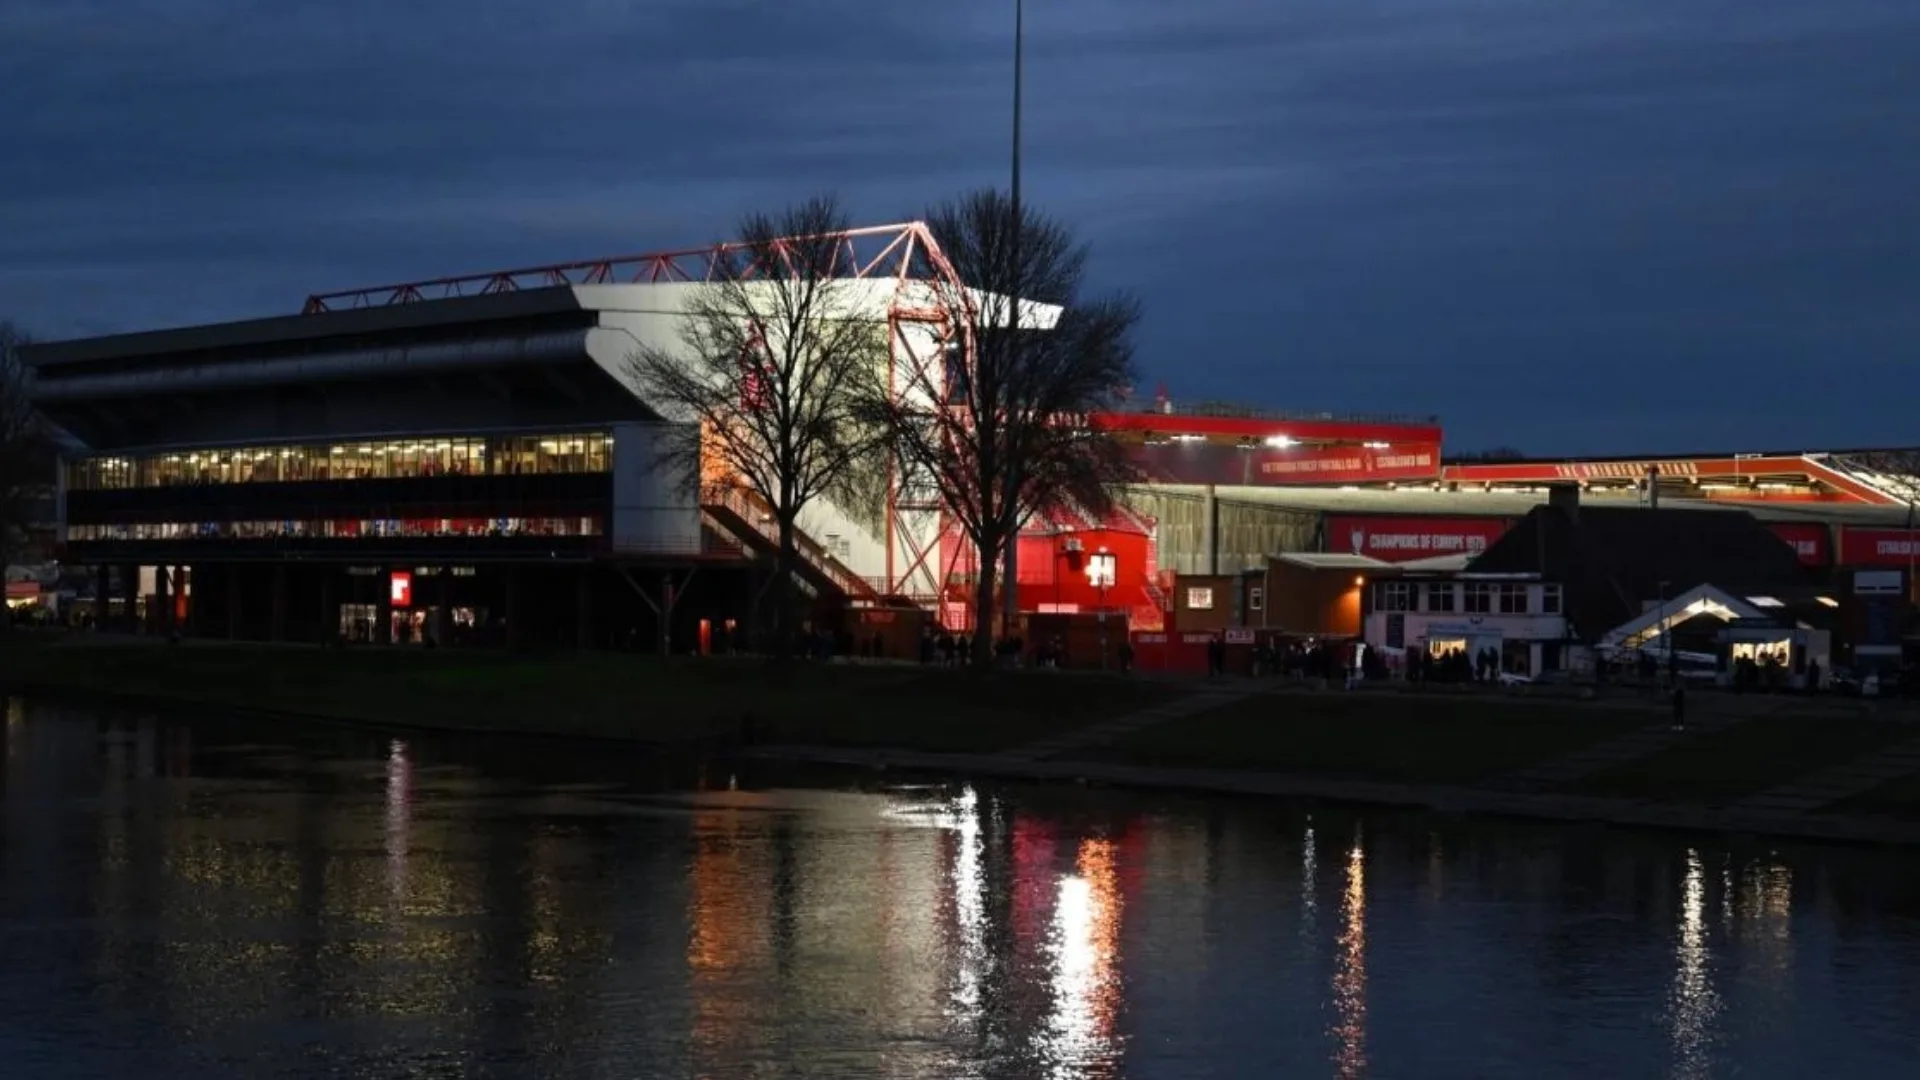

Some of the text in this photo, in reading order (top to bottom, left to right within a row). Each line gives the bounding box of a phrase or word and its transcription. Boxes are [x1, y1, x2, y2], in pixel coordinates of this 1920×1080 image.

[1370, 534, 1419, 549] CHAMPIONS
[1421, 534, 1431, 549] OF
[1432, 535, 1464, 549] EUROPE
